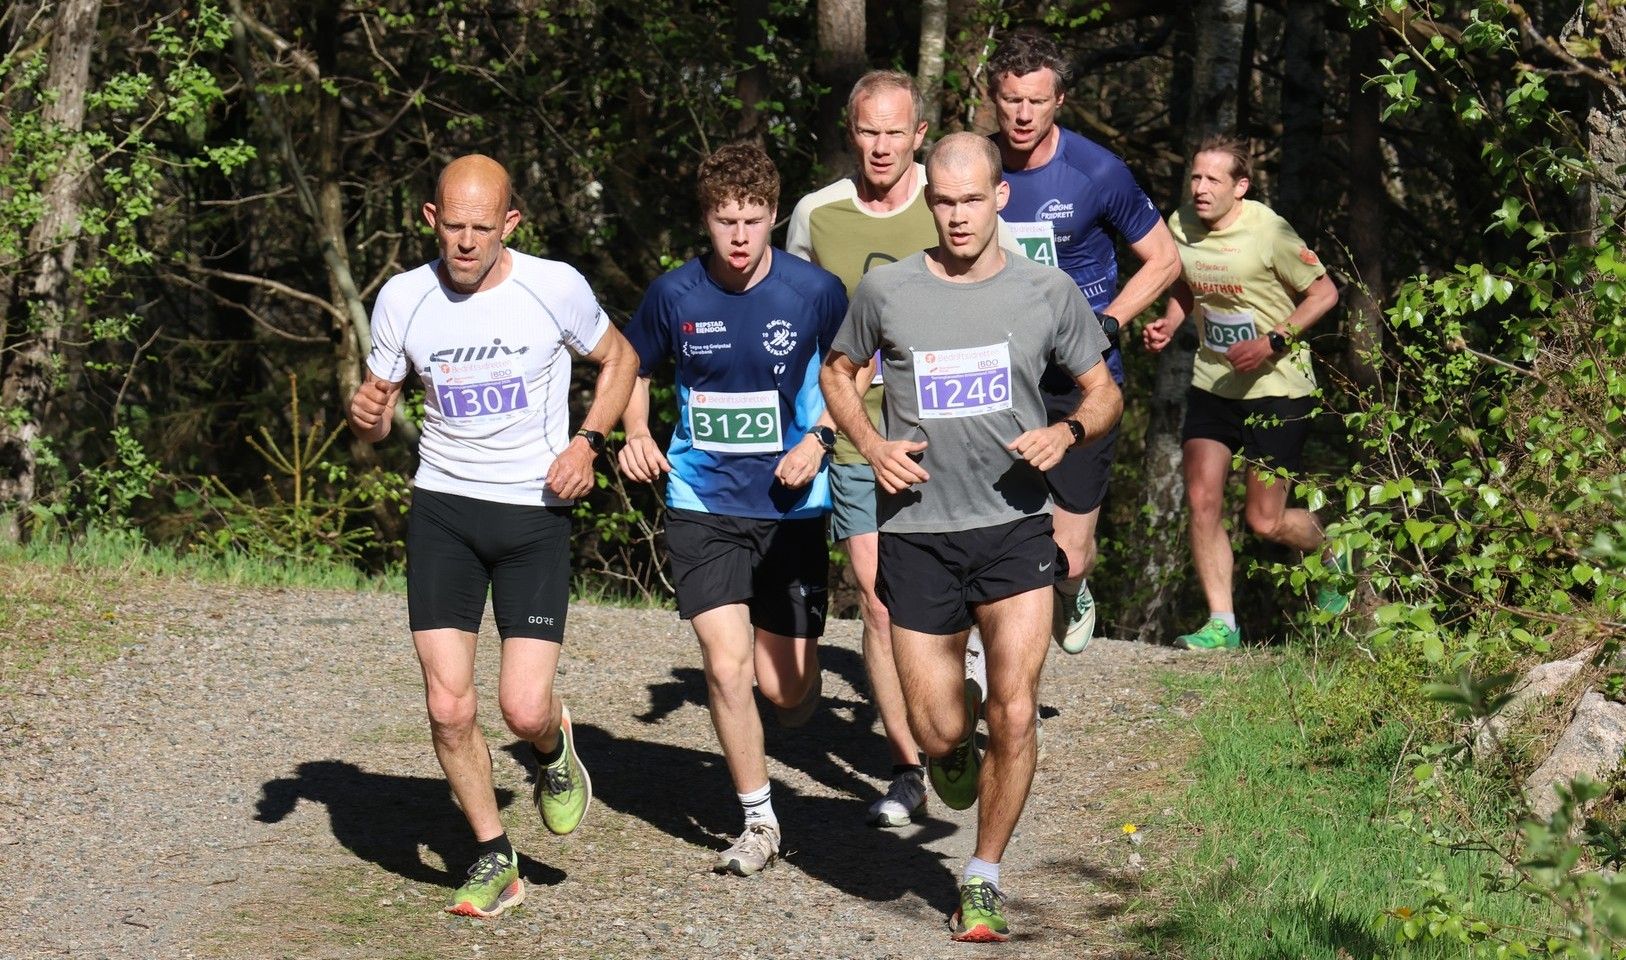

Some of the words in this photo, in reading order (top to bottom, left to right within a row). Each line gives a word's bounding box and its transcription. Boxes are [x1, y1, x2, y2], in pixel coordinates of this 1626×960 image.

[1049, 203, 1073, 212] SØGNE
[1191, 281, 1244, 294] MARATHON
[980, 358, 999, 368] BDO
[925, 373, 1007, 409] 1246
[443, 382, 521, 417] 1307
[695, 412, 774, 439] 3129
[528, 615, 554, 626] GORE
